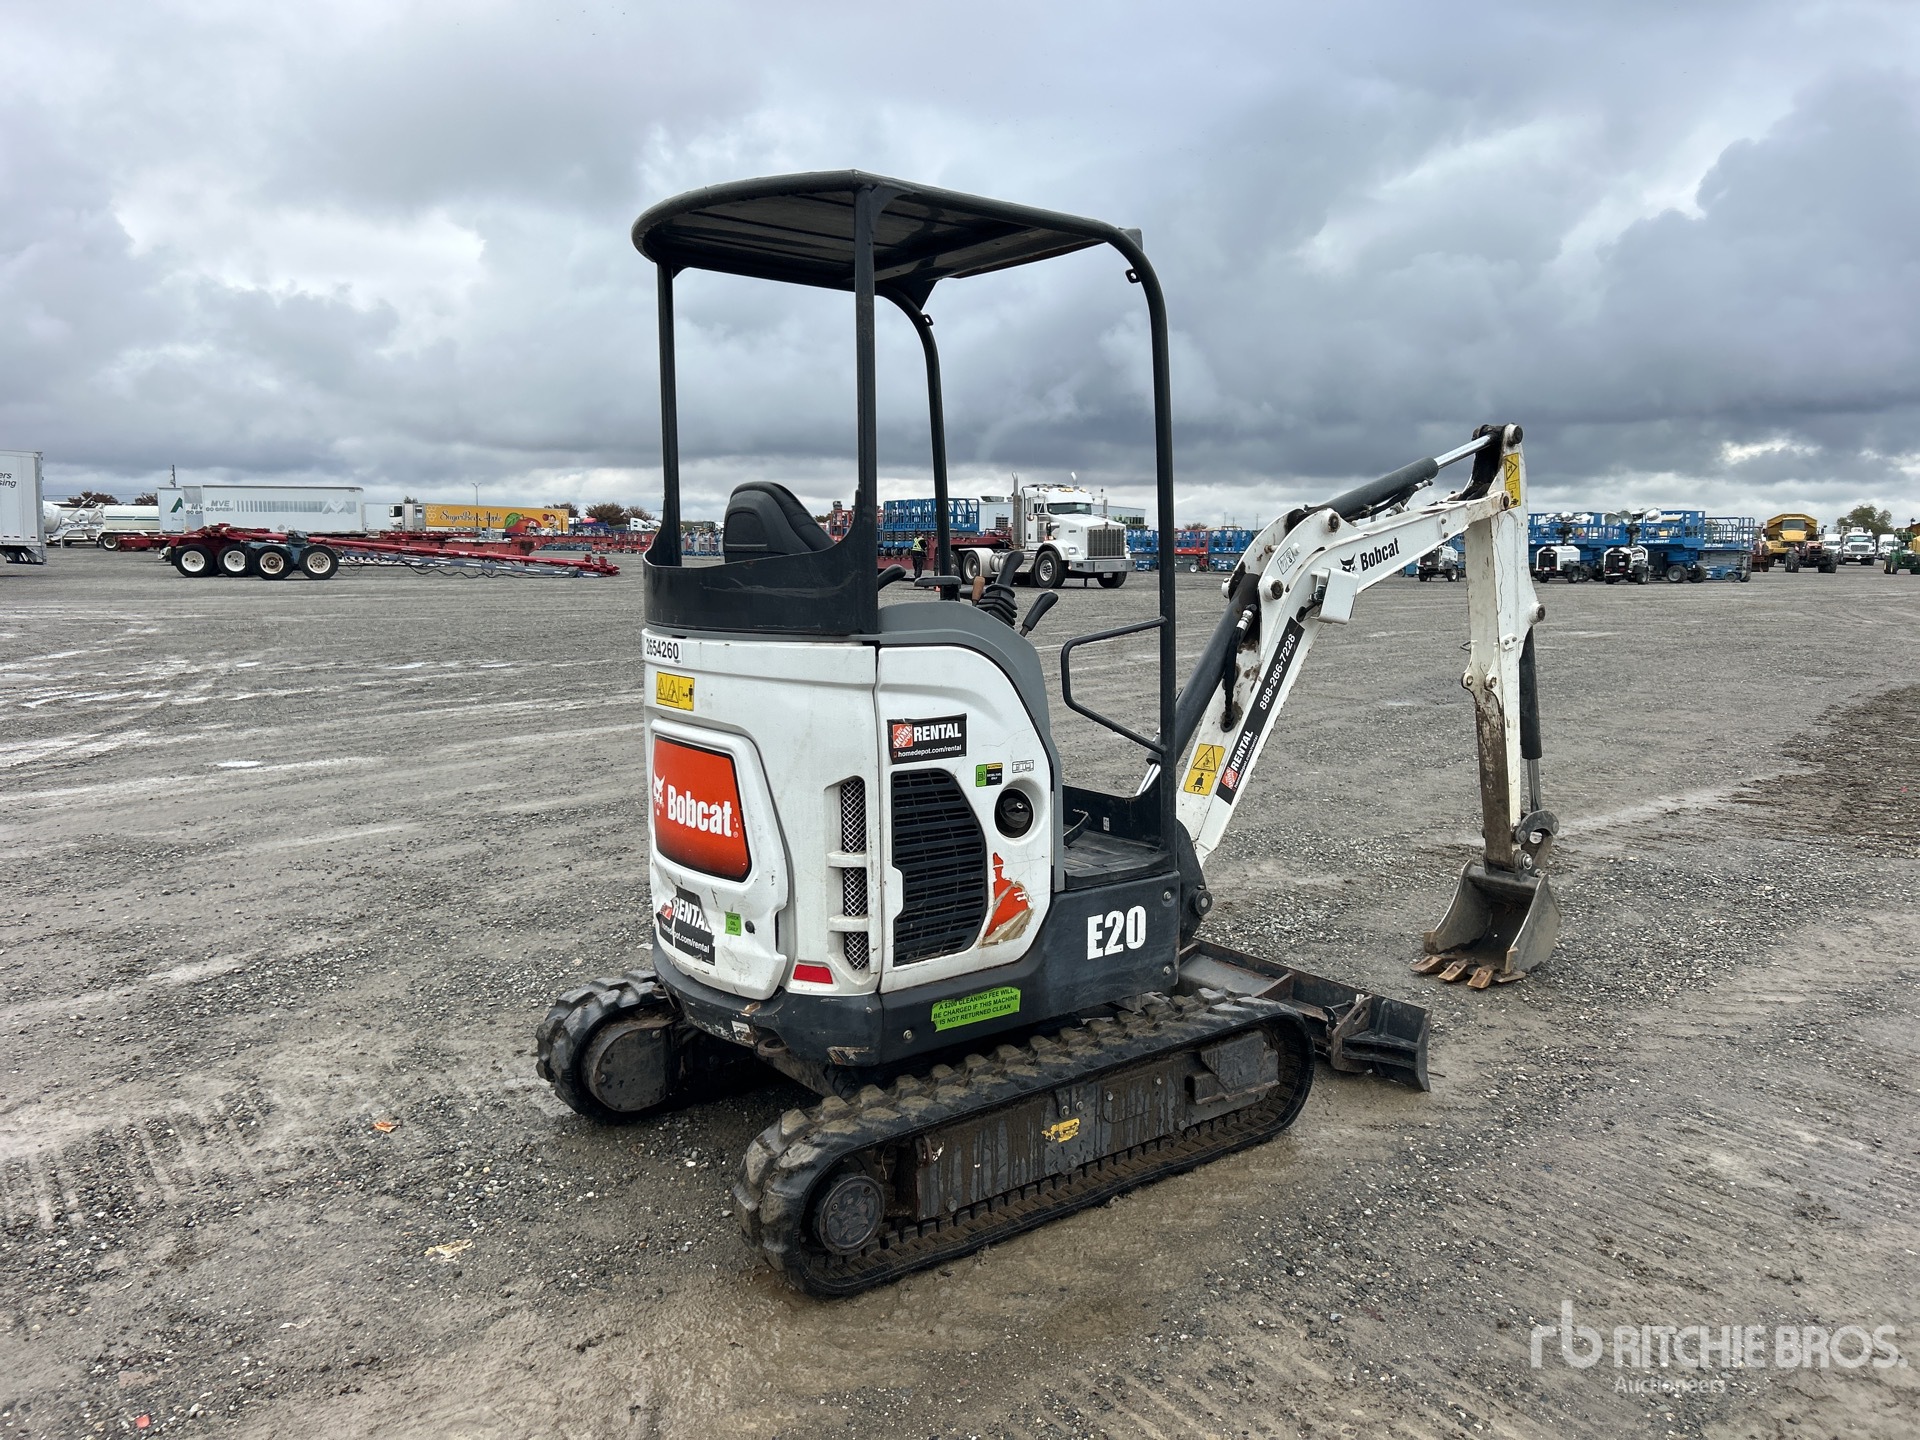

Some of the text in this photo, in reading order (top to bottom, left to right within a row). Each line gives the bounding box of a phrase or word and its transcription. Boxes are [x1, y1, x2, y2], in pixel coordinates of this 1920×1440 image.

[1360, 537, 1399, 571] Bobcat
[646, 638, 679, 660] 2654260
[1259, 633, 1296, 710] 888-266-7228
[913, 723, 962, 742] RENTAL
[898, 744, 962, 758] homedepot.com/rental
[1230, 730, 1254, 771] RENTAL
[667, 784, 732, 837] Bobcat
[1087, 905, 1147, 960] E20
[933, 1011, 942, 1019] BE
[942, 1004, 972, 1017] CHARGED
[979, 1000, 992, 1009] THIS
[992, 994, 1019, 1005] MACHINE
[944, 1000, 958, 1009] $200
[958, 994, 988, 1006] CLEANING
[988, 990, 1000, 999] FEE
[1000, 988, 1014, 996] WILL
[960, 1008, 992, 1021] RETURNED
[991, 1004, 1012, 1013] CLEAN
